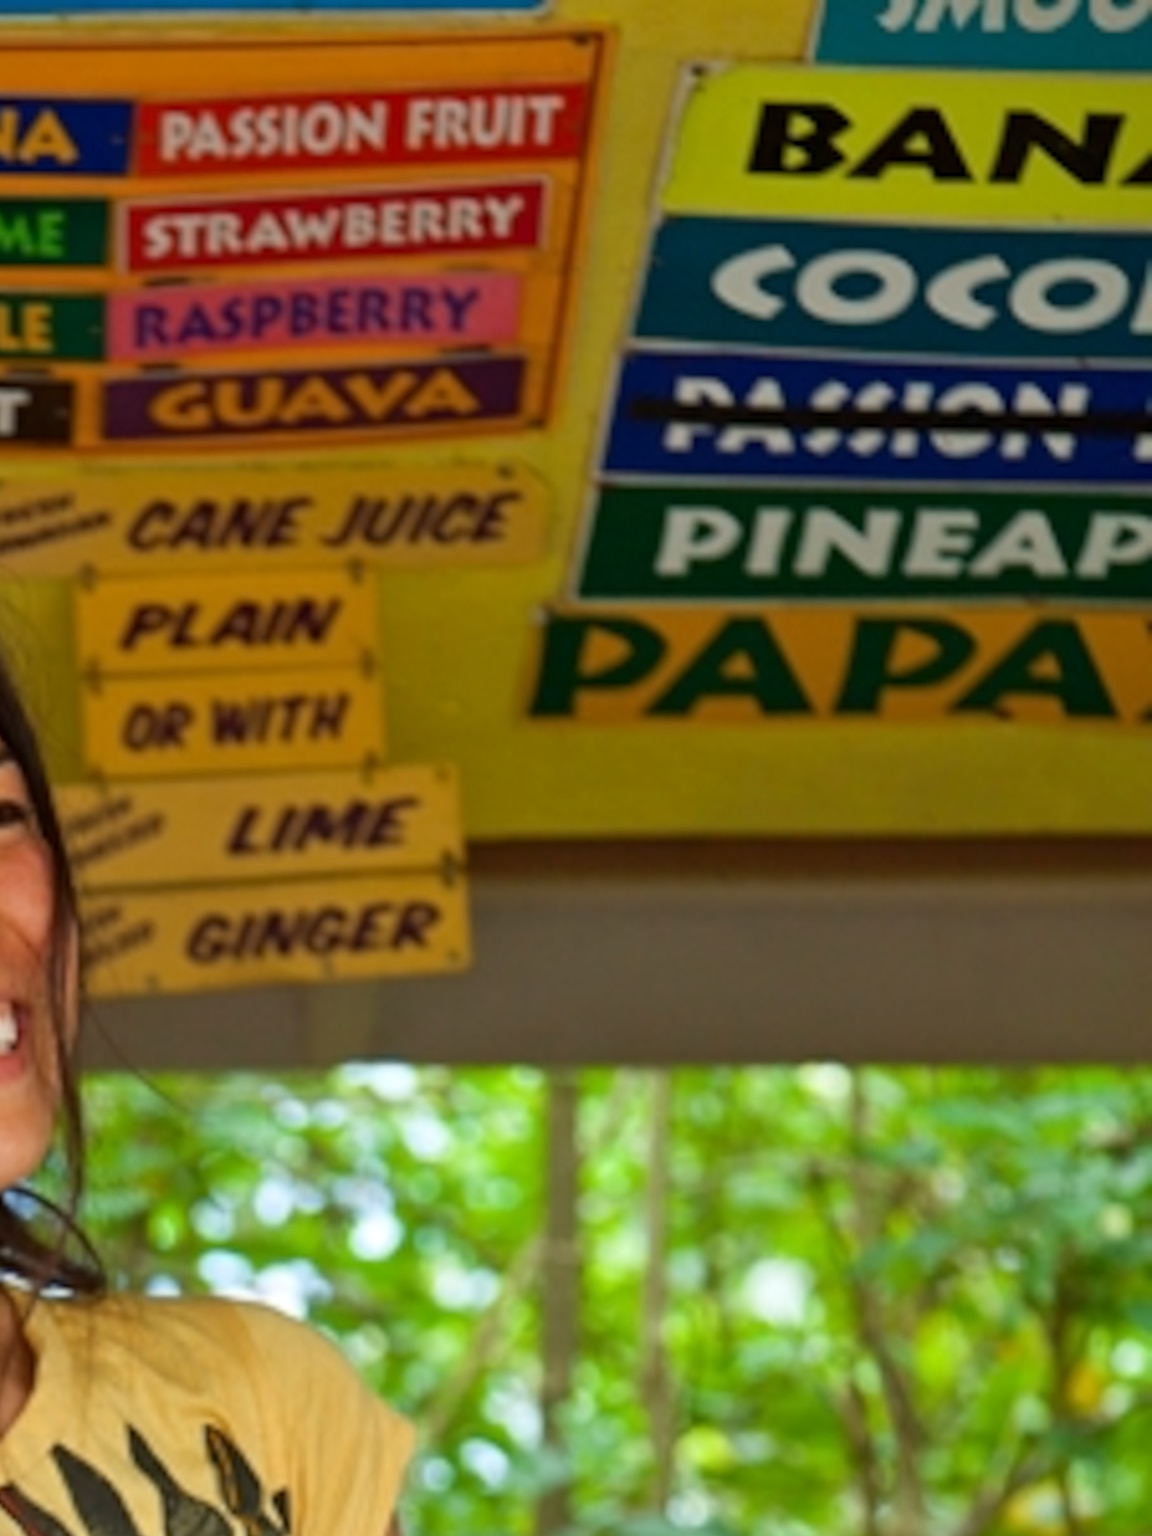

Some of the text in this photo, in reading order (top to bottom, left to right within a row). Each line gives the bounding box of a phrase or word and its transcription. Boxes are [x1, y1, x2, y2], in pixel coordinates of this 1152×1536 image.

[159, 94, 566, 162] PASSION FRUIT
[744, 101, 1152, 188] BAN
[142, 192, 526, 262] STRAWBERRY
[132, 285, 480, 350] RASPBERRY
[710, 243, 1152, 336] COCO
[149, 367, 481, 430] GUAVA
[662, 374, 1092, 461] PASSION
[125, 495, 316, 553] CANE
[320, 490, 525, 548] JUICE
[118, 596, 344, 653] PLAIN
[526, 614, 1152, 722] PAPA
[120, 692, 354, 754] OR WITH
[225, 795, 421, 857] LIME
[184, 900, 444, 965] GINGER
